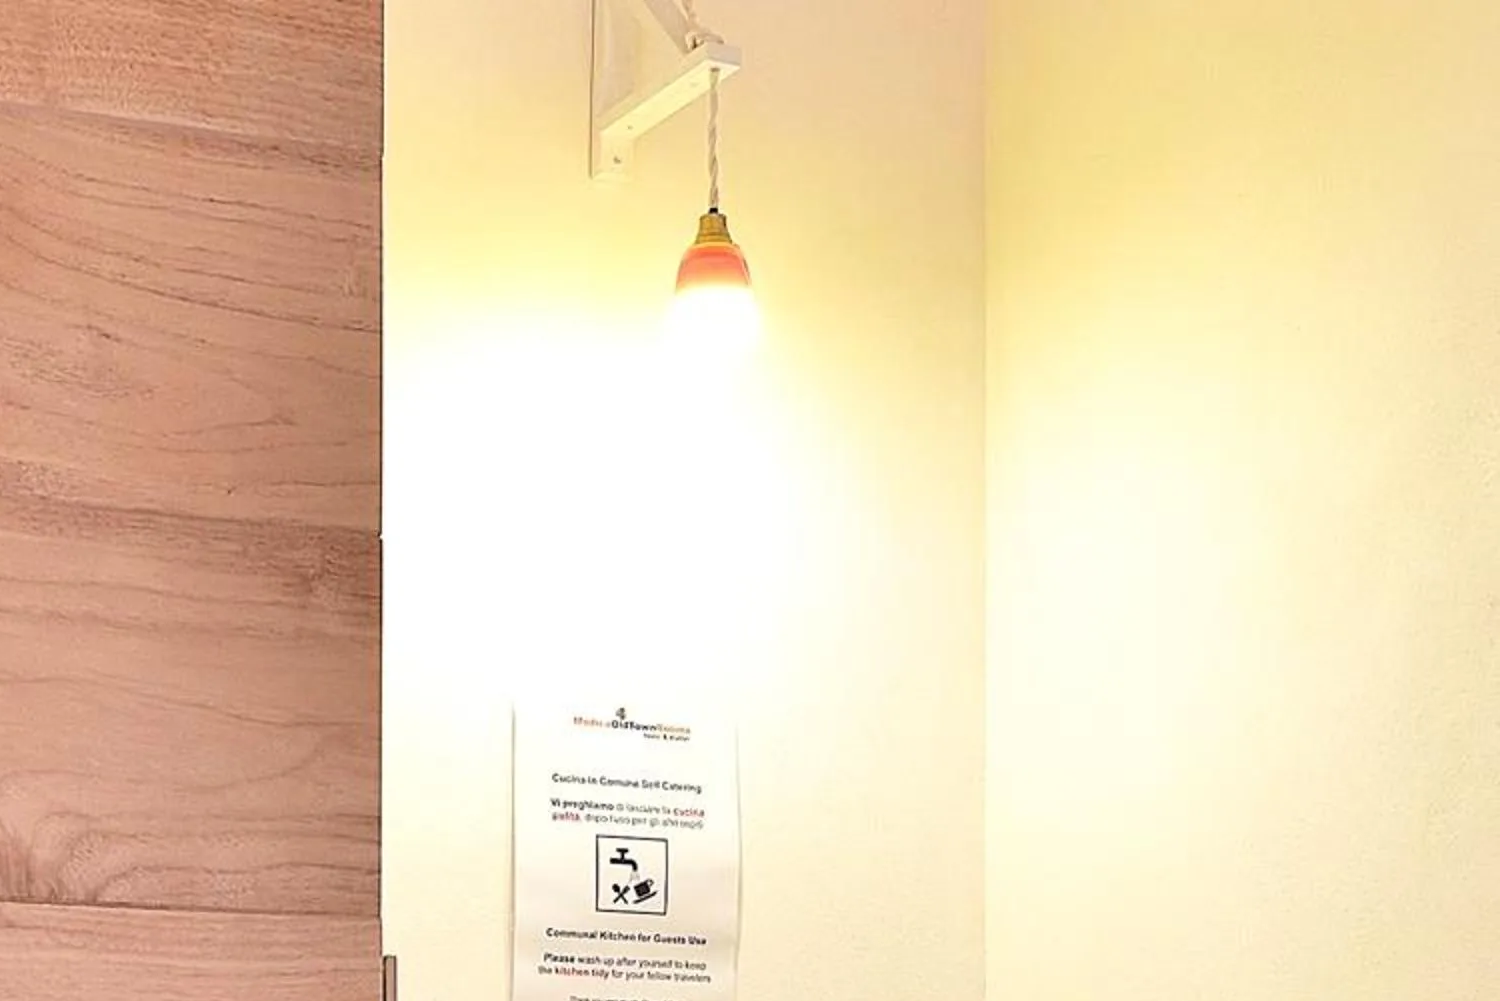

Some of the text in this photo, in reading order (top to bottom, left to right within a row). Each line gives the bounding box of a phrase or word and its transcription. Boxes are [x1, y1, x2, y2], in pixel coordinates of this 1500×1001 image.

[662, 781, 701, 794] Catering
[545, 928, 596, 939] Communal
[600, 931, 636, 941] Kitchen
[638, 933, 651, 942] for
[654, 934, 686, 944] Guests
[543, 952, 575, 963] Please
[554, 966, 590, 977] kitchen
[591, 968, 609, 980] tidy
